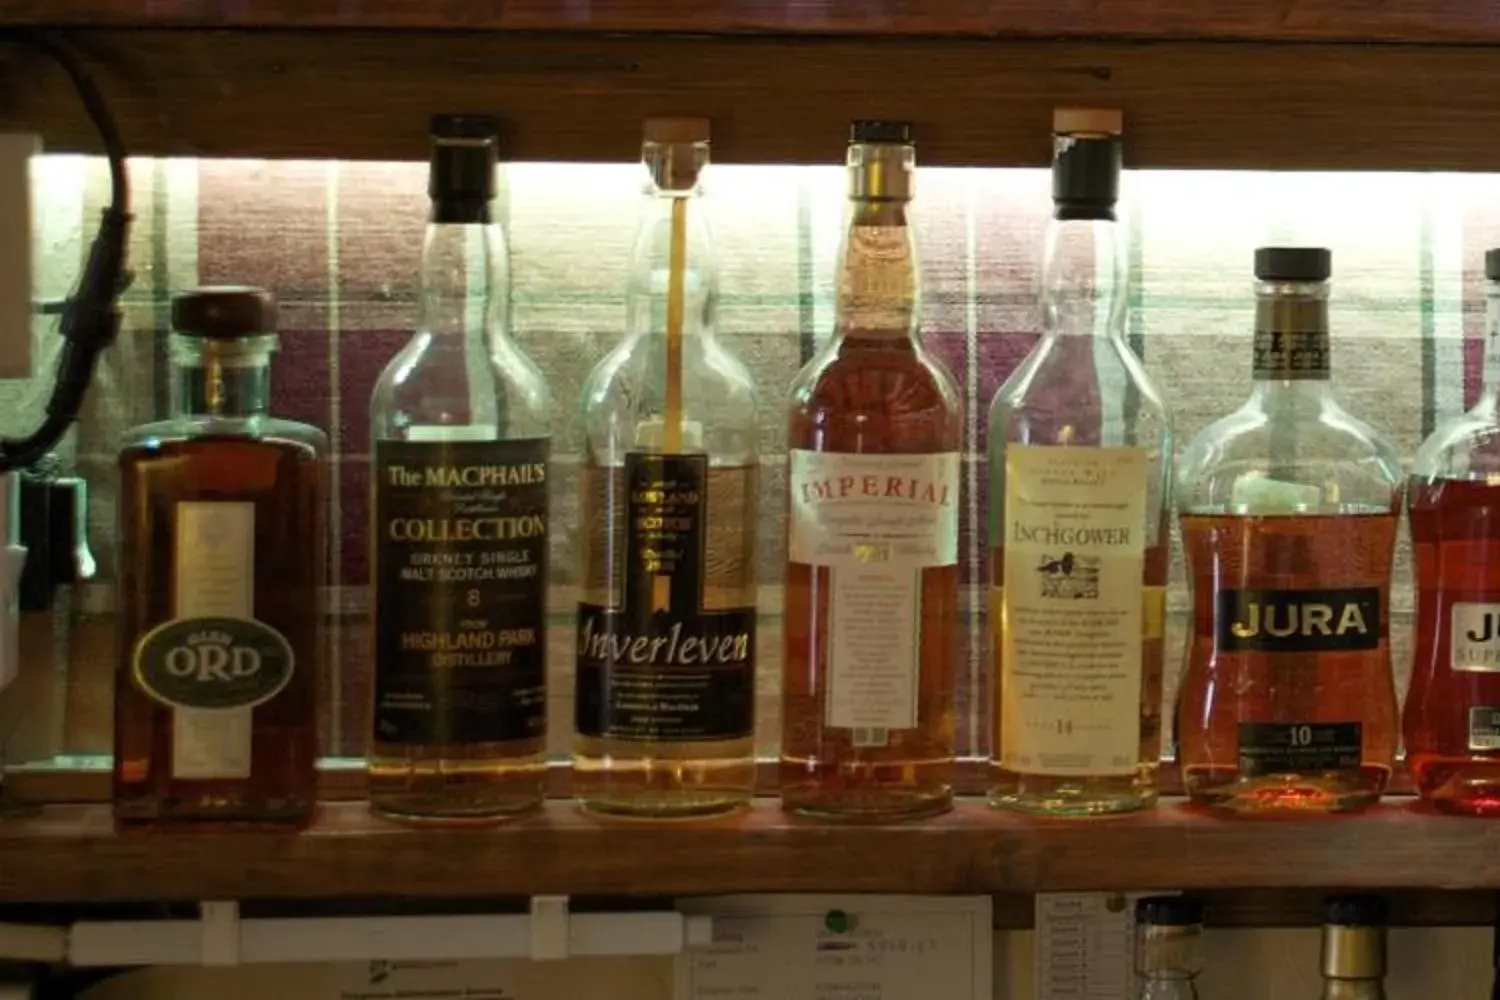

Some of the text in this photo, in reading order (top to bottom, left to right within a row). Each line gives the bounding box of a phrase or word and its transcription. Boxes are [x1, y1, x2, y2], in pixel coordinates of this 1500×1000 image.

[388, 465, 425, 488] The
[801, 474, 950, 508] IMPERIAL
[389, 516, 546, 542] COLLECTION
[1013, 520, 1131, 546] INCHGOWER
[438, 564, 494, 580] SCOTCH
[1231, 601, 1368, 638] JURA
[402, 628, 536, 651] HIGHLAND PARK
[580, 616, 750, 664] Inverleven
[165, 644, 262, 682] ORD
[1289, 725, 1313, 746] 10
